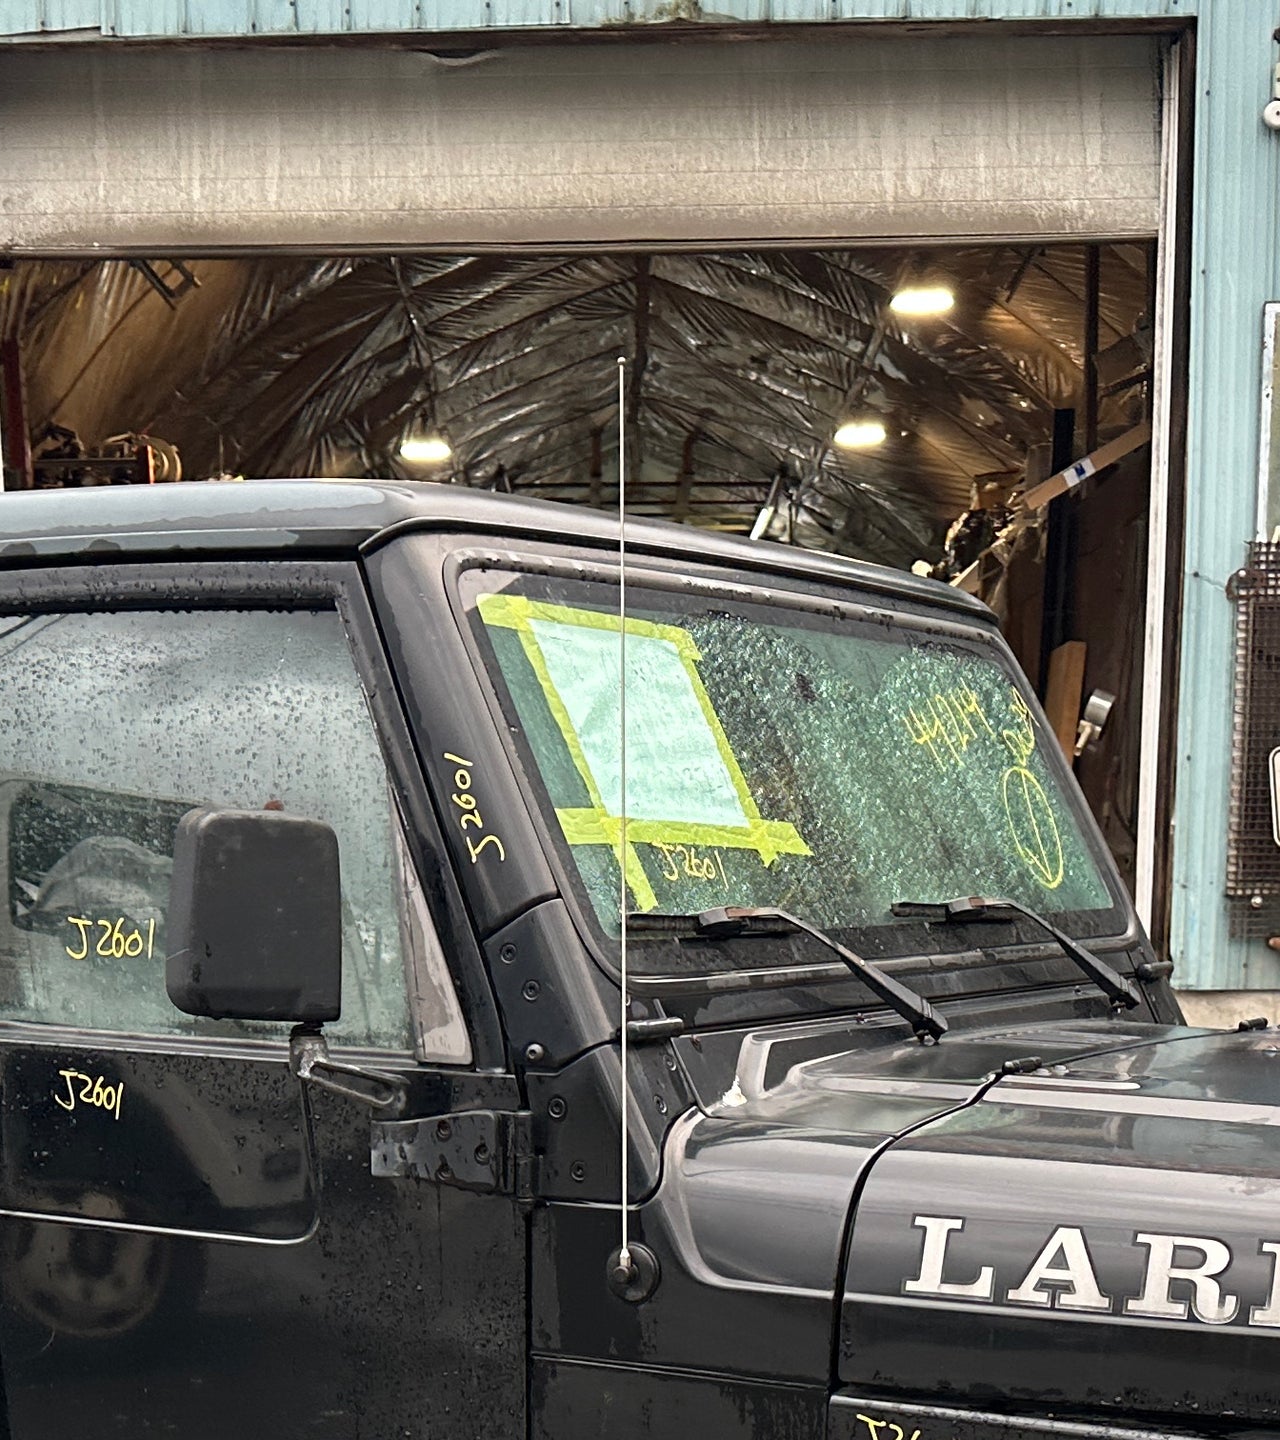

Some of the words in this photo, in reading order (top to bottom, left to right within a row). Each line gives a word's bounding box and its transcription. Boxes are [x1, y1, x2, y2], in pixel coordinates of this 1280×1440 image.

[443, 753, 505, 864] J2601
[66, 917, 155, 960] J2601
[55, 1070, 124, 1120] J2601
